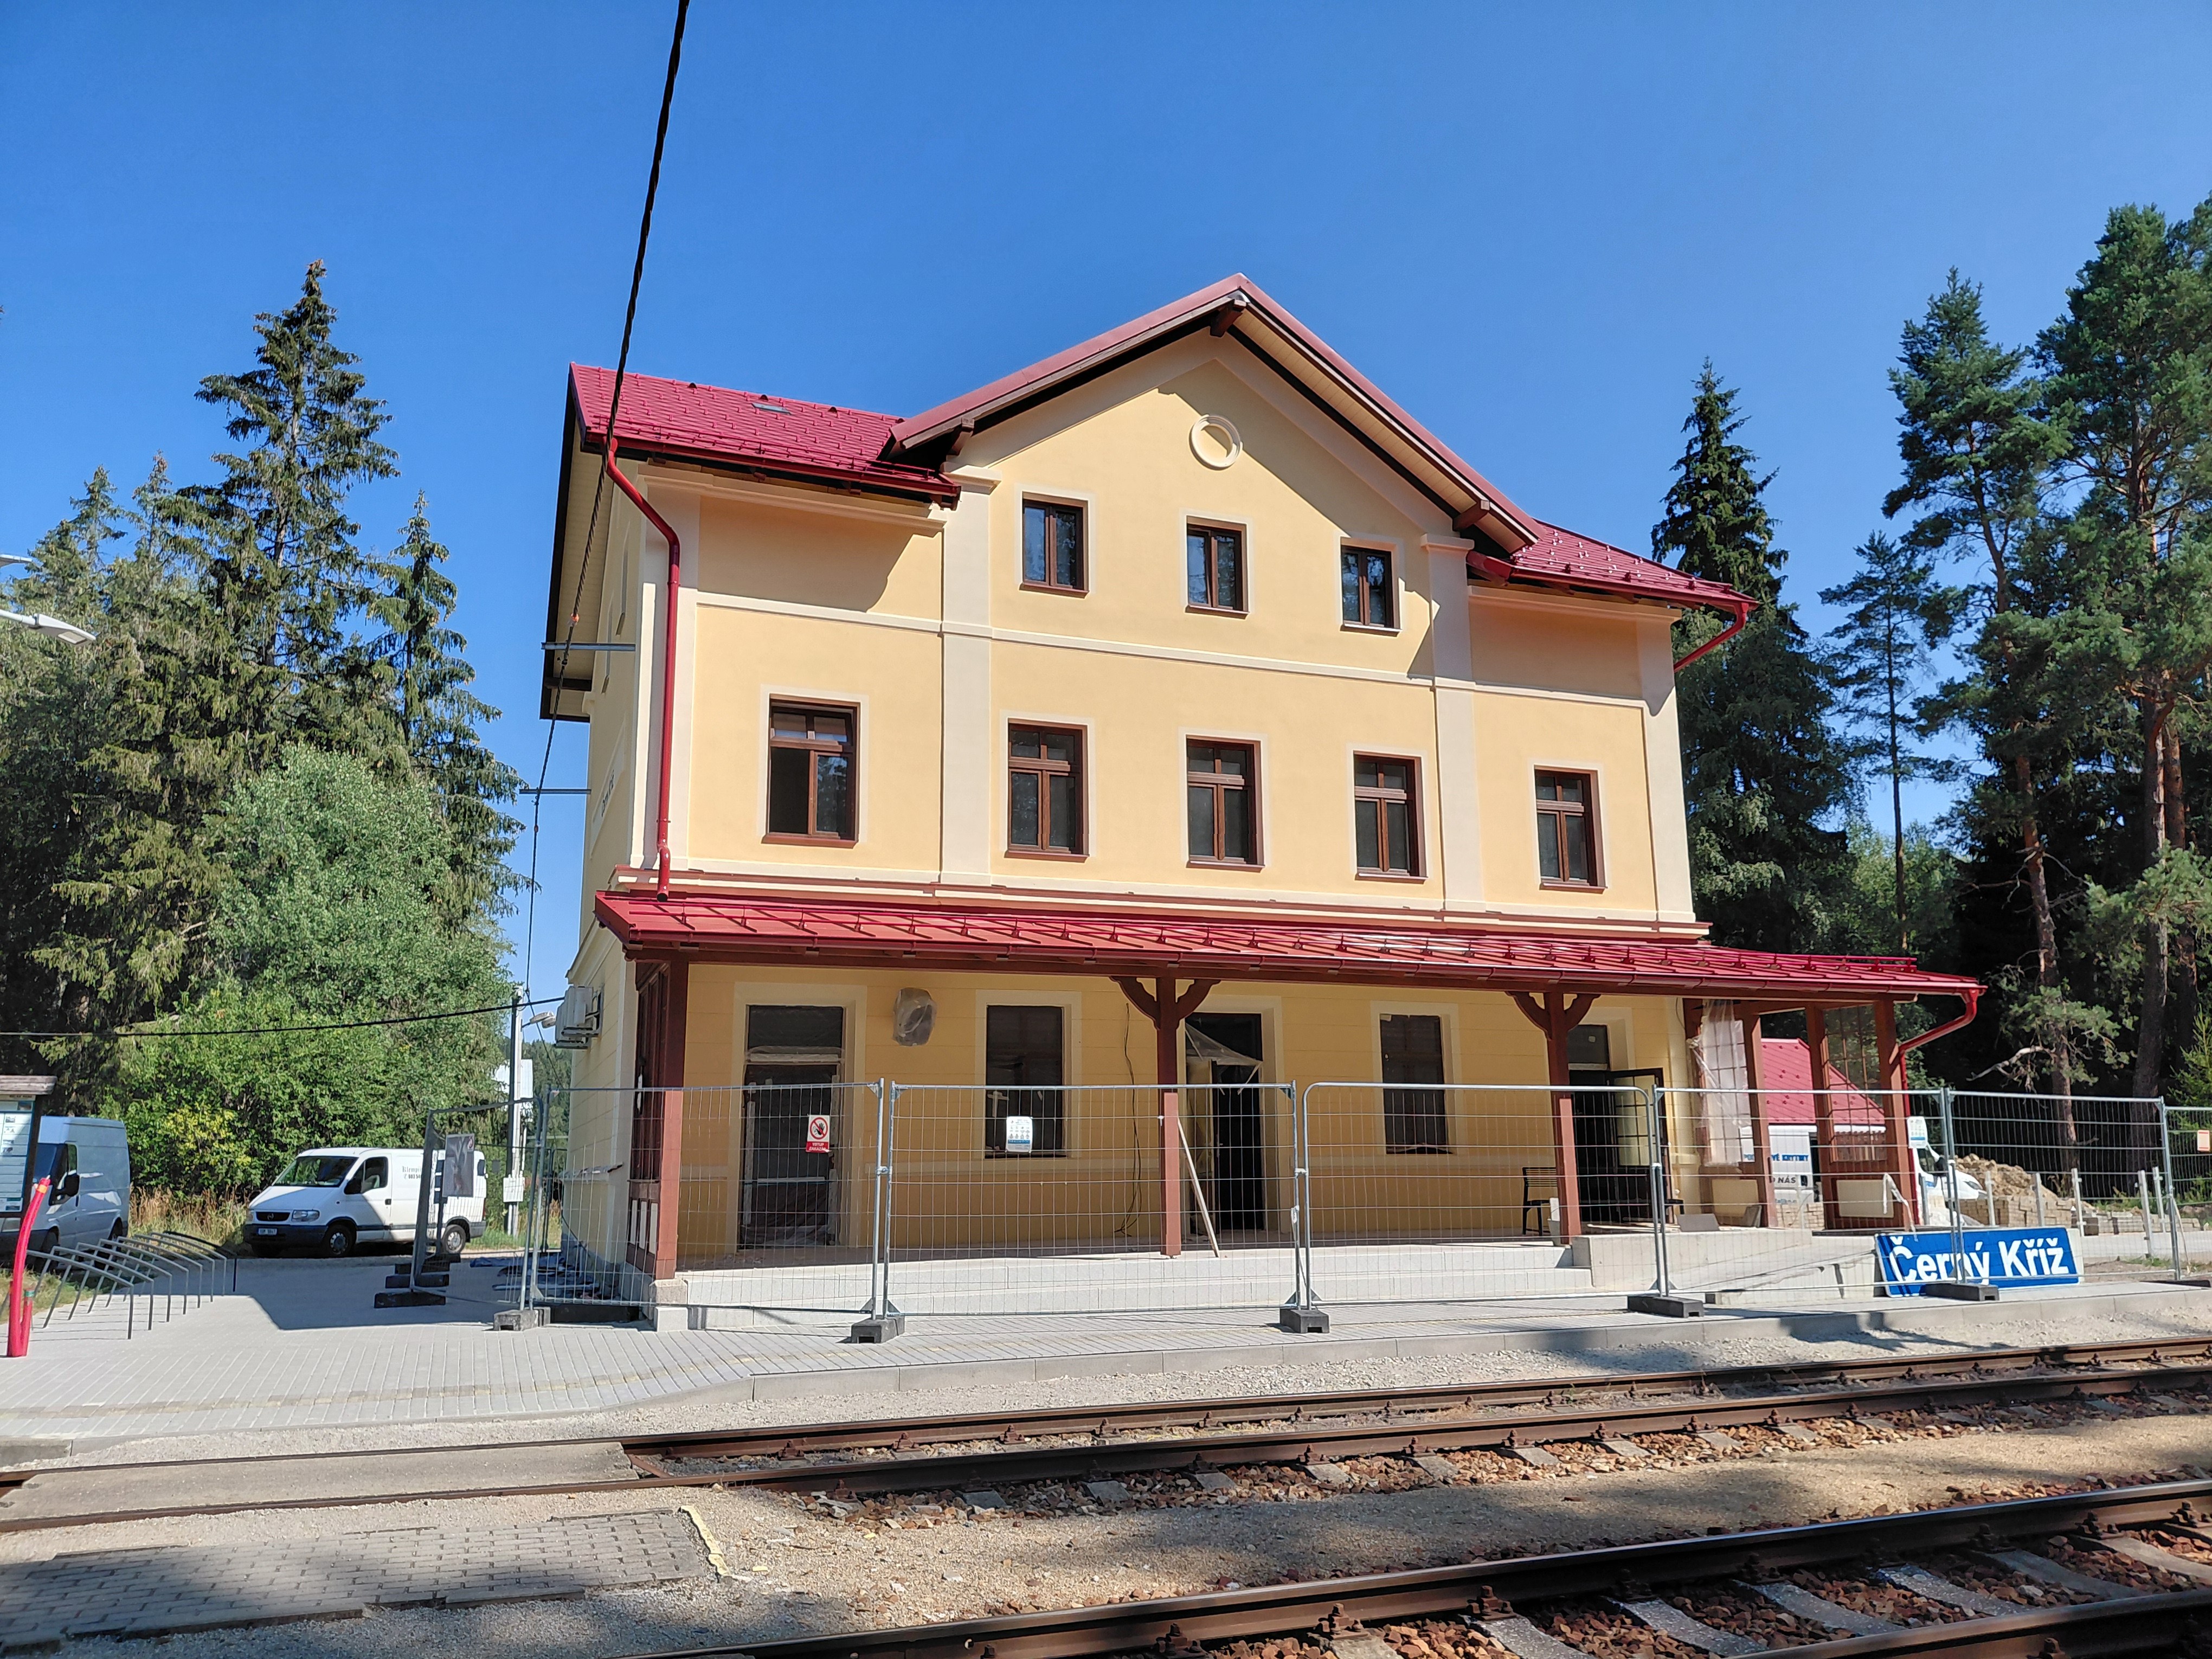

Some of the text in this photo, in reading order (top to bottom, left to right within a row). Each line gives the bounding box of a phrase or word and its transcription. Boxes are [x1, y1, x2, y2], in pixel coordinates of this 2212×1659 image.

[1778, 1175, 1796, 1184] NÁS
[1889, 1236, 2069, 1285] Černý Kříž
